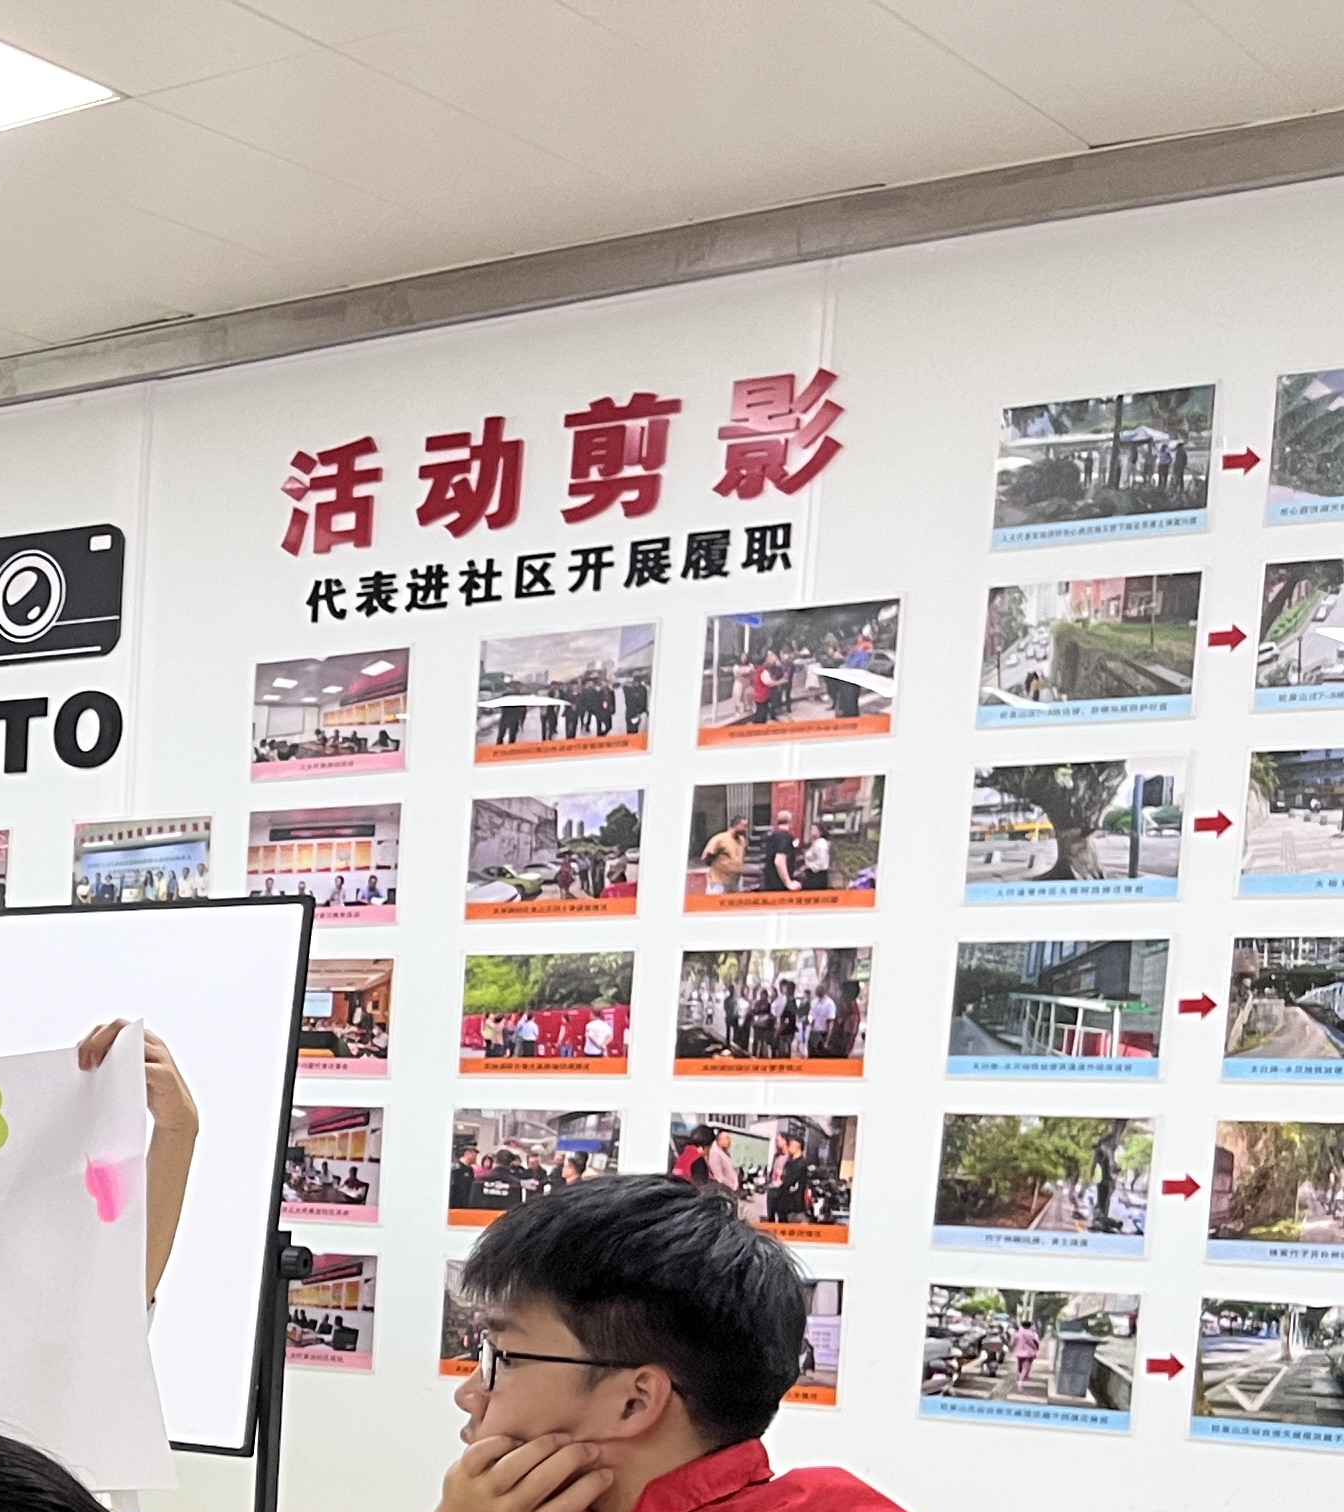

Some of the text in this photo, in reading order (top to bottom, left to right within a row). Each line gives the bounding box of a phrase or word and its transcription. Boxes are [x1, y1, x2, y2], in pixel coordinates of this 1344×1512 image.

[280, 366, 846, 557] 活动剪影
[305, 523, 794, 624] 代表进社区开展履职
